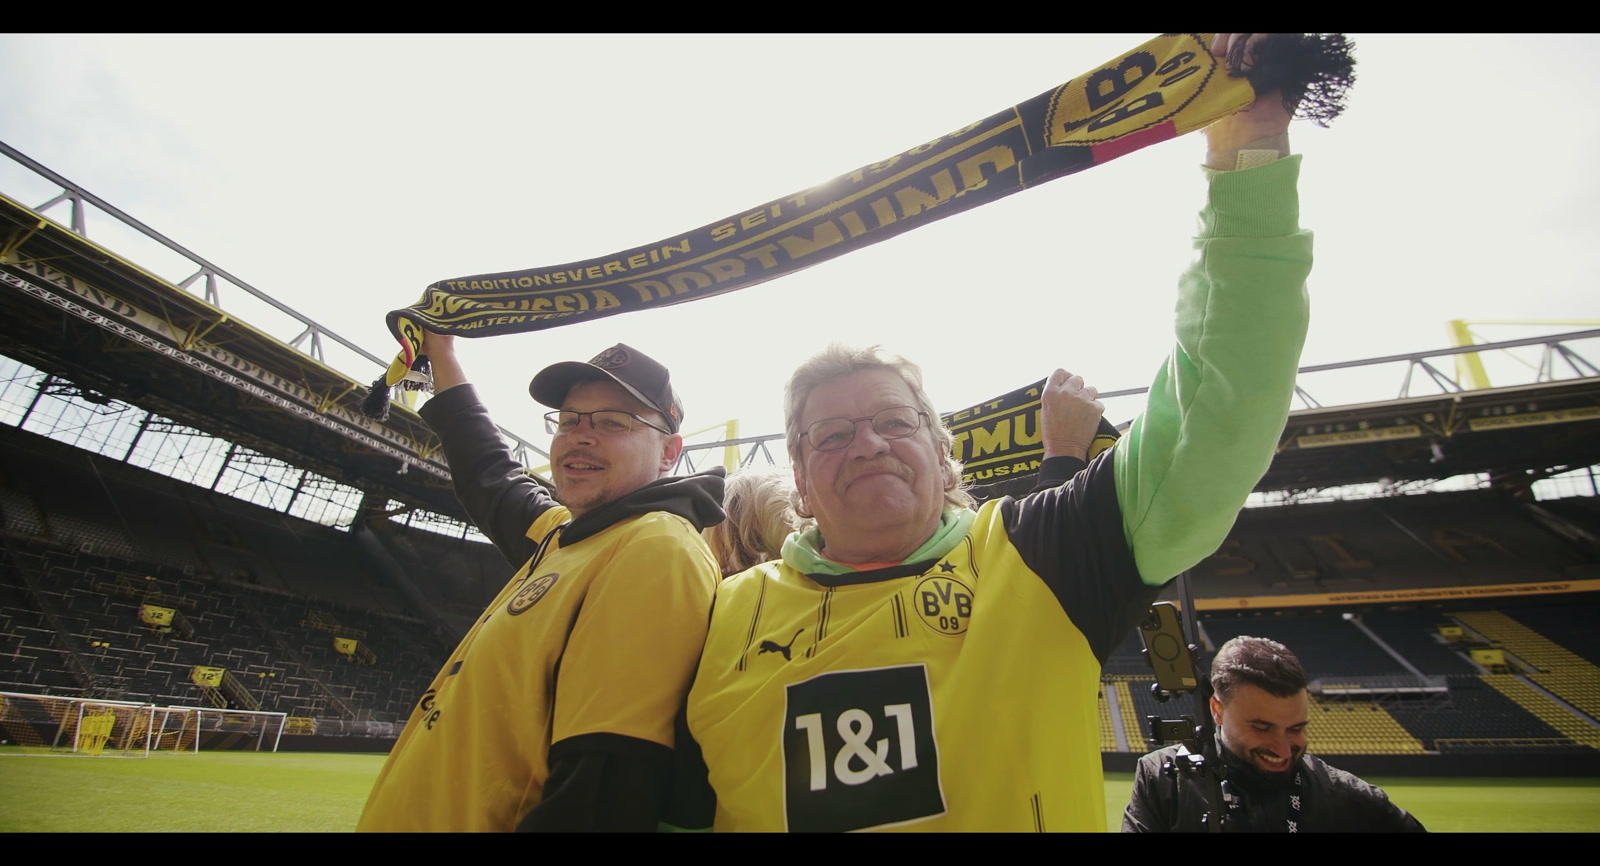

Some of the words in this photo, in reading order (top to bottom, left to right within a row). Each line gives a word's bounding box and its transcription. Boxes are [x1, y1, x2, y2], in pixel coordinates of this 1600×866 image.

[446, 239, 691, 291] TRADITIONSVEREIN
[710, 190, 813, 242] SEIT
[519, 577, 551, 601] BVB
[921, 580, 972, 618] BVB
[151, 611, 164, 620] 12
[939, 615, 959, 630] 09
[202, 672, 214, 681] 12
[795, 703, 918, 791] 1&1
